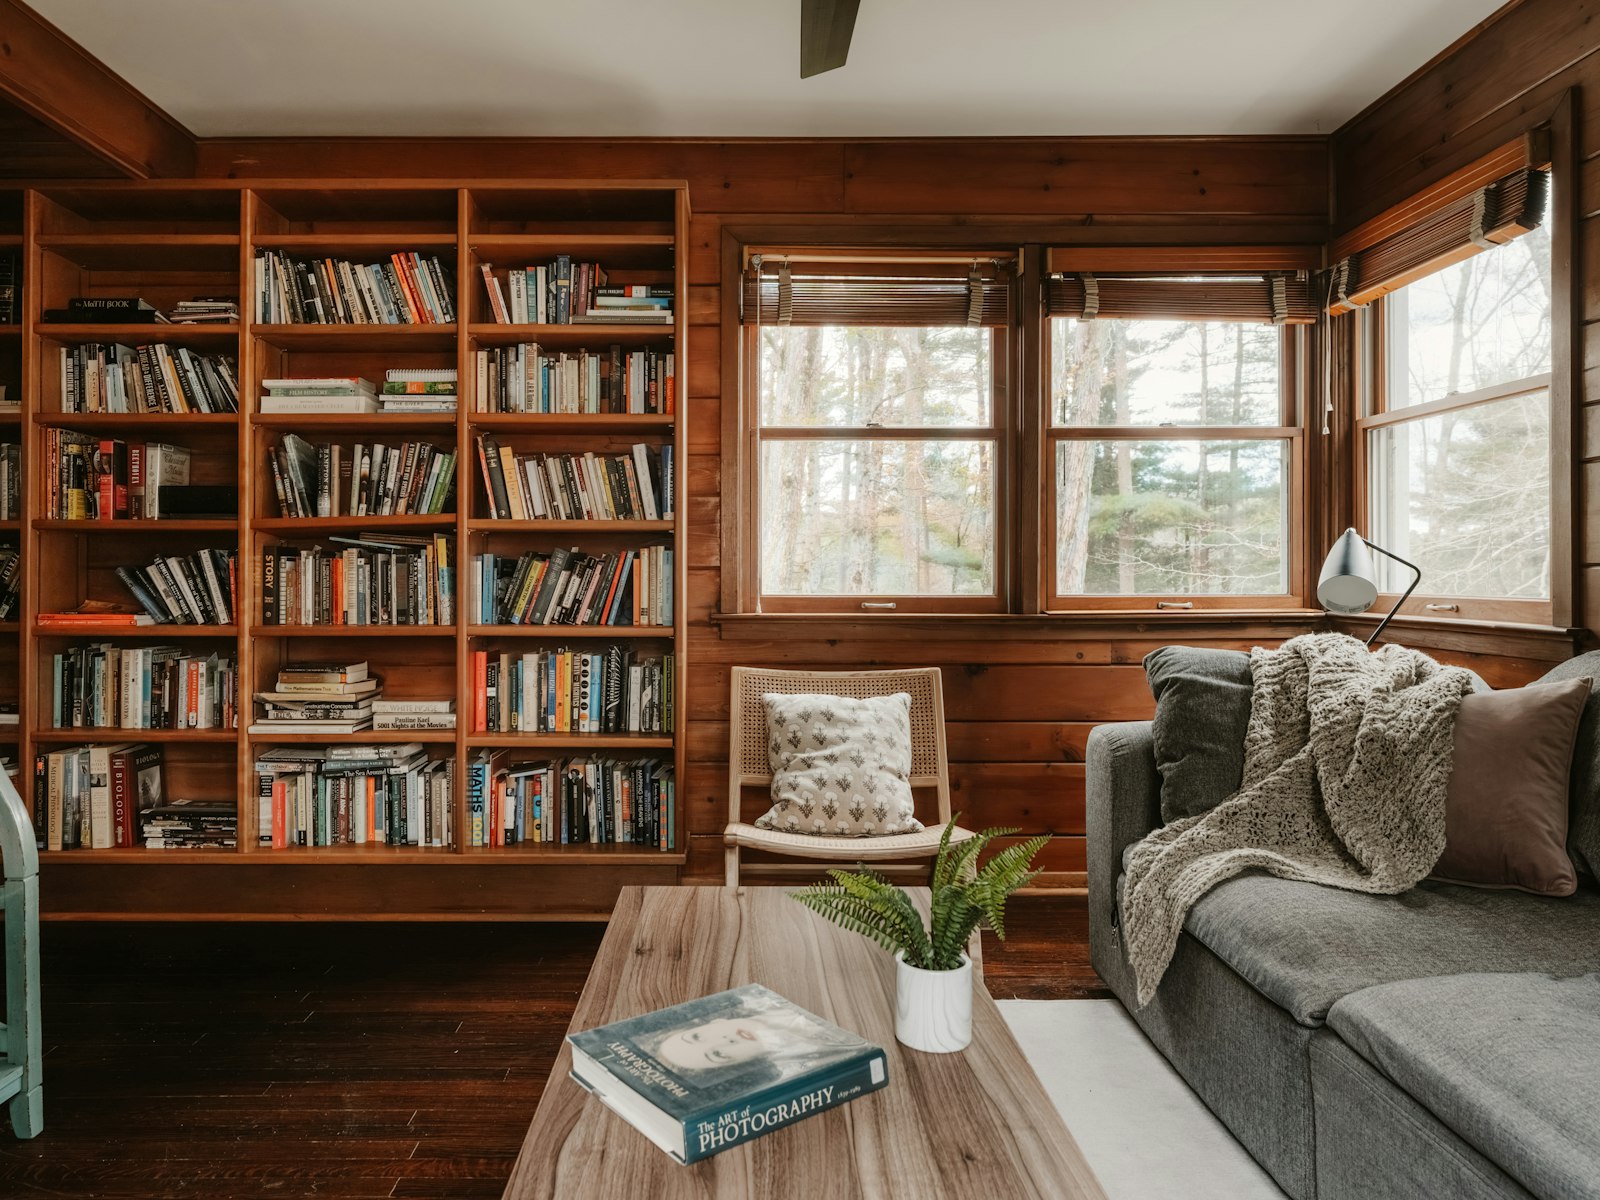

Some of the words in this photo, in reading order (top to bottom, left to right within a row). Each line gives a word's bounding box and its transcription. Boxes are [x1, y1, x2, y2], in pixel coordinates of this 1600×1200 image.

[144, 373, 156, 406] DIFFERENCE
[264, 554, 273, 588] STORY
[522, 574, 534, 602] SYMMETRY
[115, 772, 123, 822] BIOLOGY
[472, 767, 482, 812] MATHS
[472, 816, 482, 845] 1001
[606, 1042, 689, 1097] PHOTOGRAPHY
[624, 1066, 641, 1076] ART
[697, 1122, 714, 1134] The
[718, 1110, 738, 1128] ART
[741, 1105, 750, 1118] of
[698, 1086, 834, 1153] PHOTOGRAPHY
